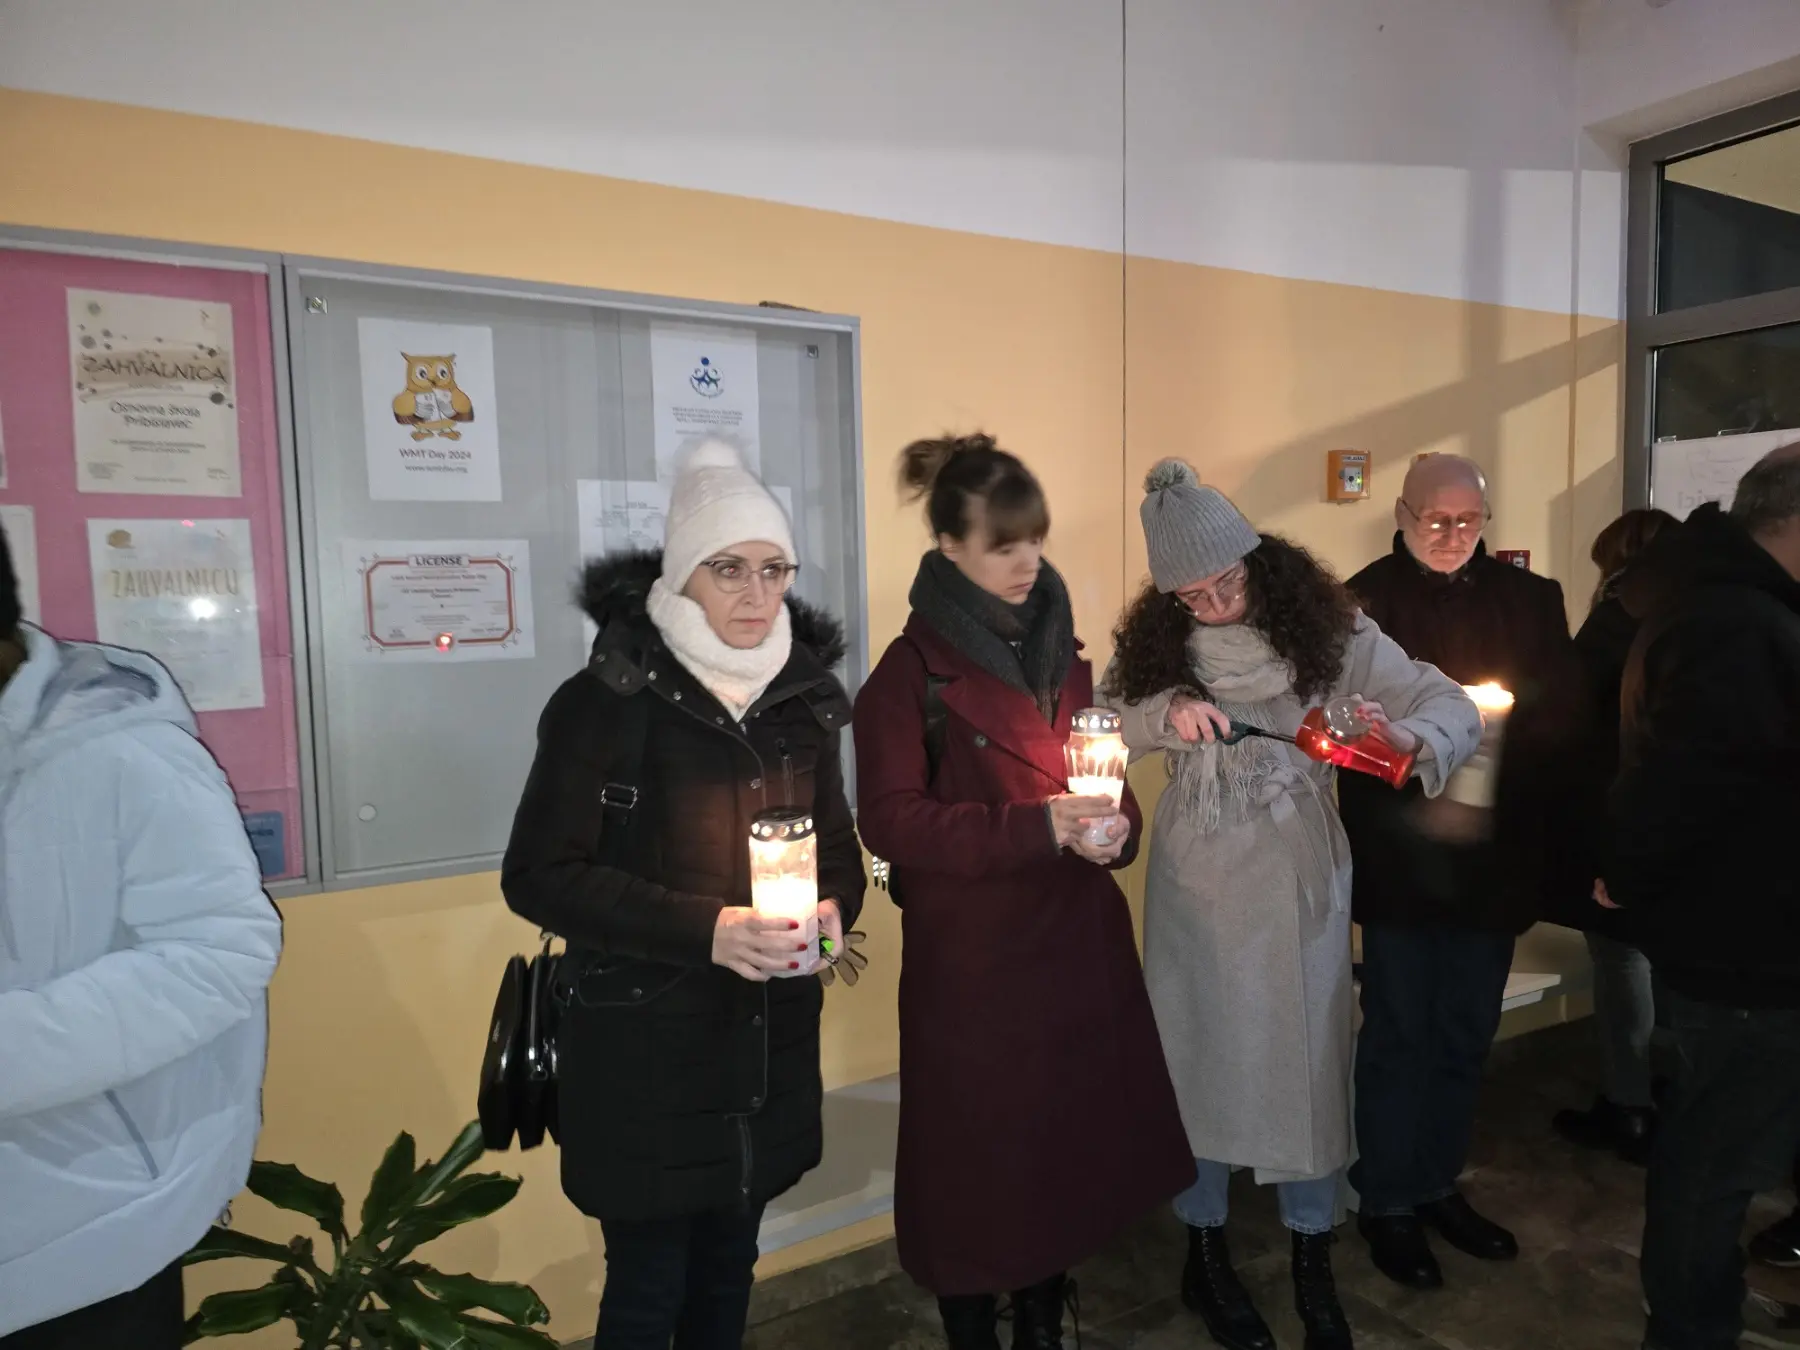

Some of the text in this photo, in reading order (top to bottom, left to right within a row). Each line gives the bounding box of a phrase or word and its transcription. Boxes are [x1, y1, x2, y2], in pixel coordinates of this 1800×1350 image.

[81, 352, 228, 384] ZAHVALNICA
[415, 555, 463, 567] LICENSE
[109, 567, 240, 598] ZAHVALNICU
